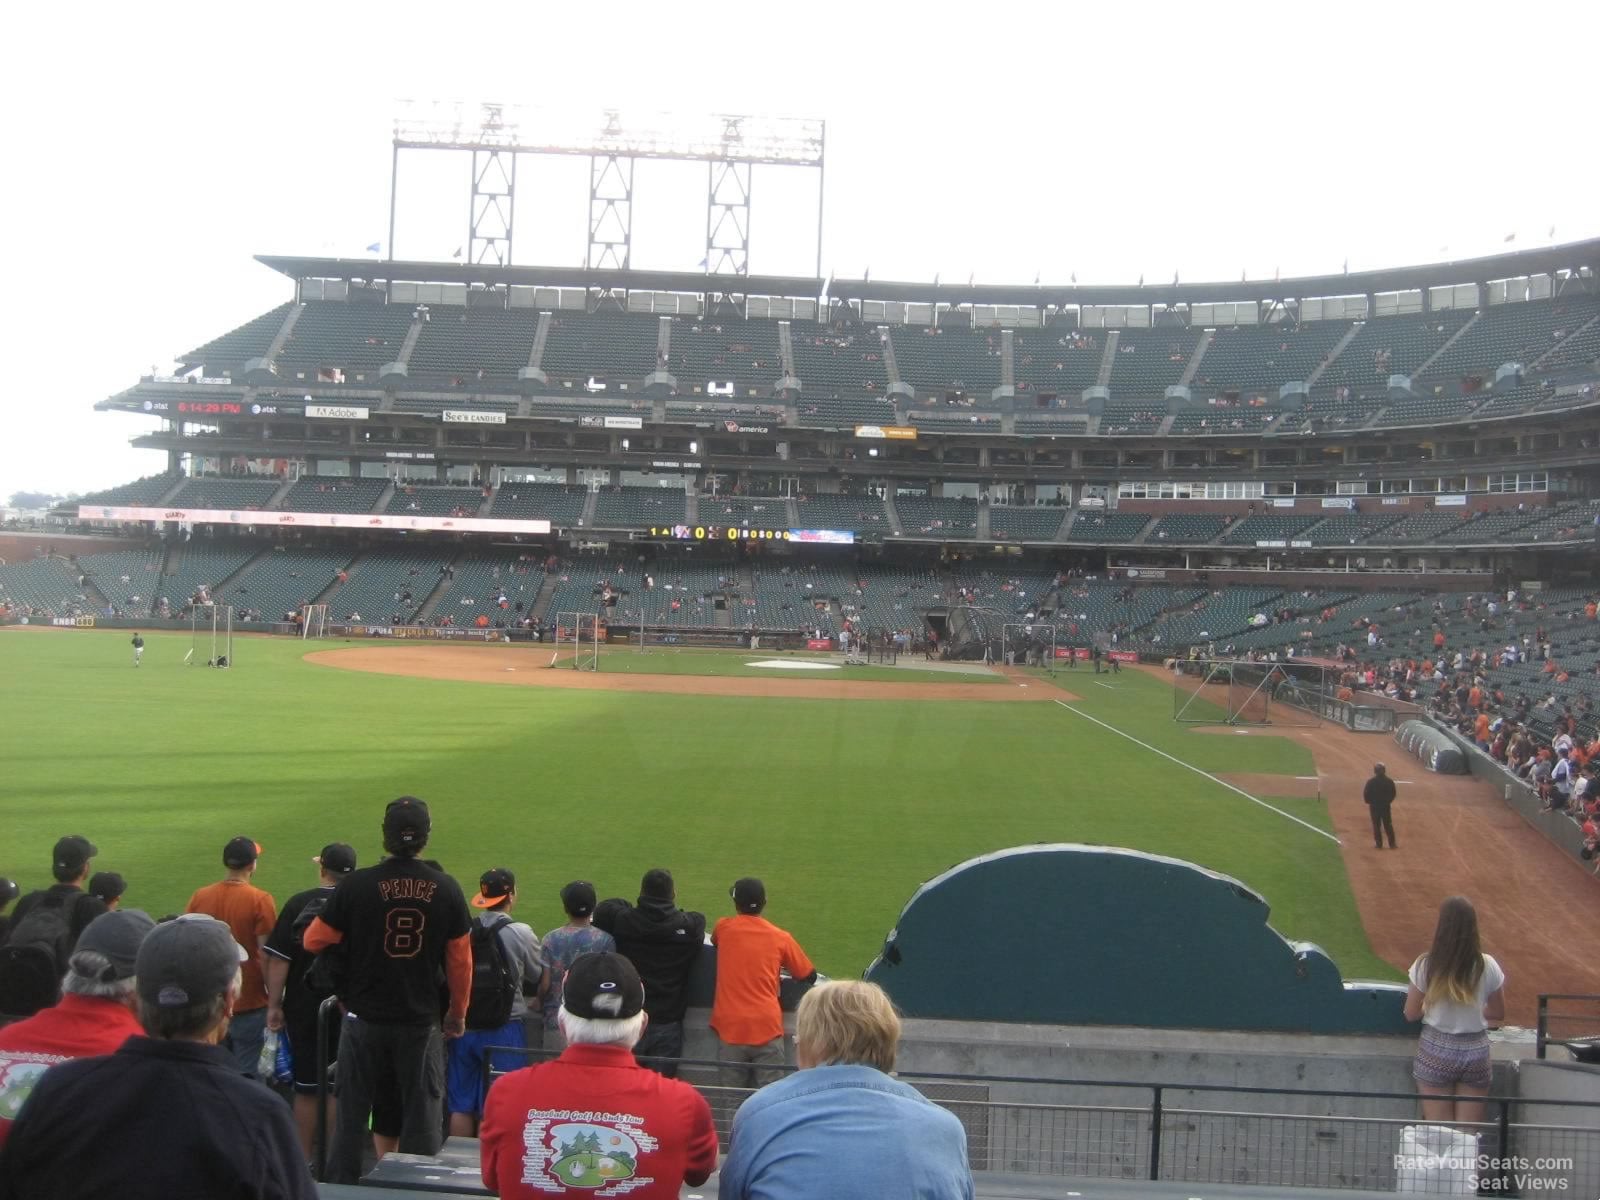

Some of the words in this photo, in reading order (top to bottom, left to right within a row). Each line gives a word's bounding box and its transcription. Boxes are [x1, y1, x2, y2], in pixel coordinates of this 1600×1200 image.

[220, 402, 241, 414] PM
[328, 408, 358, 418] Adobe
[445, 411, 469, 422] See's
[470, 414, 503, 423] CANDIES
[738, 426, 769, 434] america
[650, 527, 657, 536] 1
[695, 527, 705, 538] 0
[728, 527, 737, 539] 0
[53, 617, 76, 626] KNBR
[378, 878, 437, 903] PENCE
[384, 907, 425, 958] 8
[528, 1108, 570, 1119] Baseball
[570, 1110, 593, 1122] Golf
[593, 1112, 601, 1120] &
[625, 1114, 644, 1124] Tour
